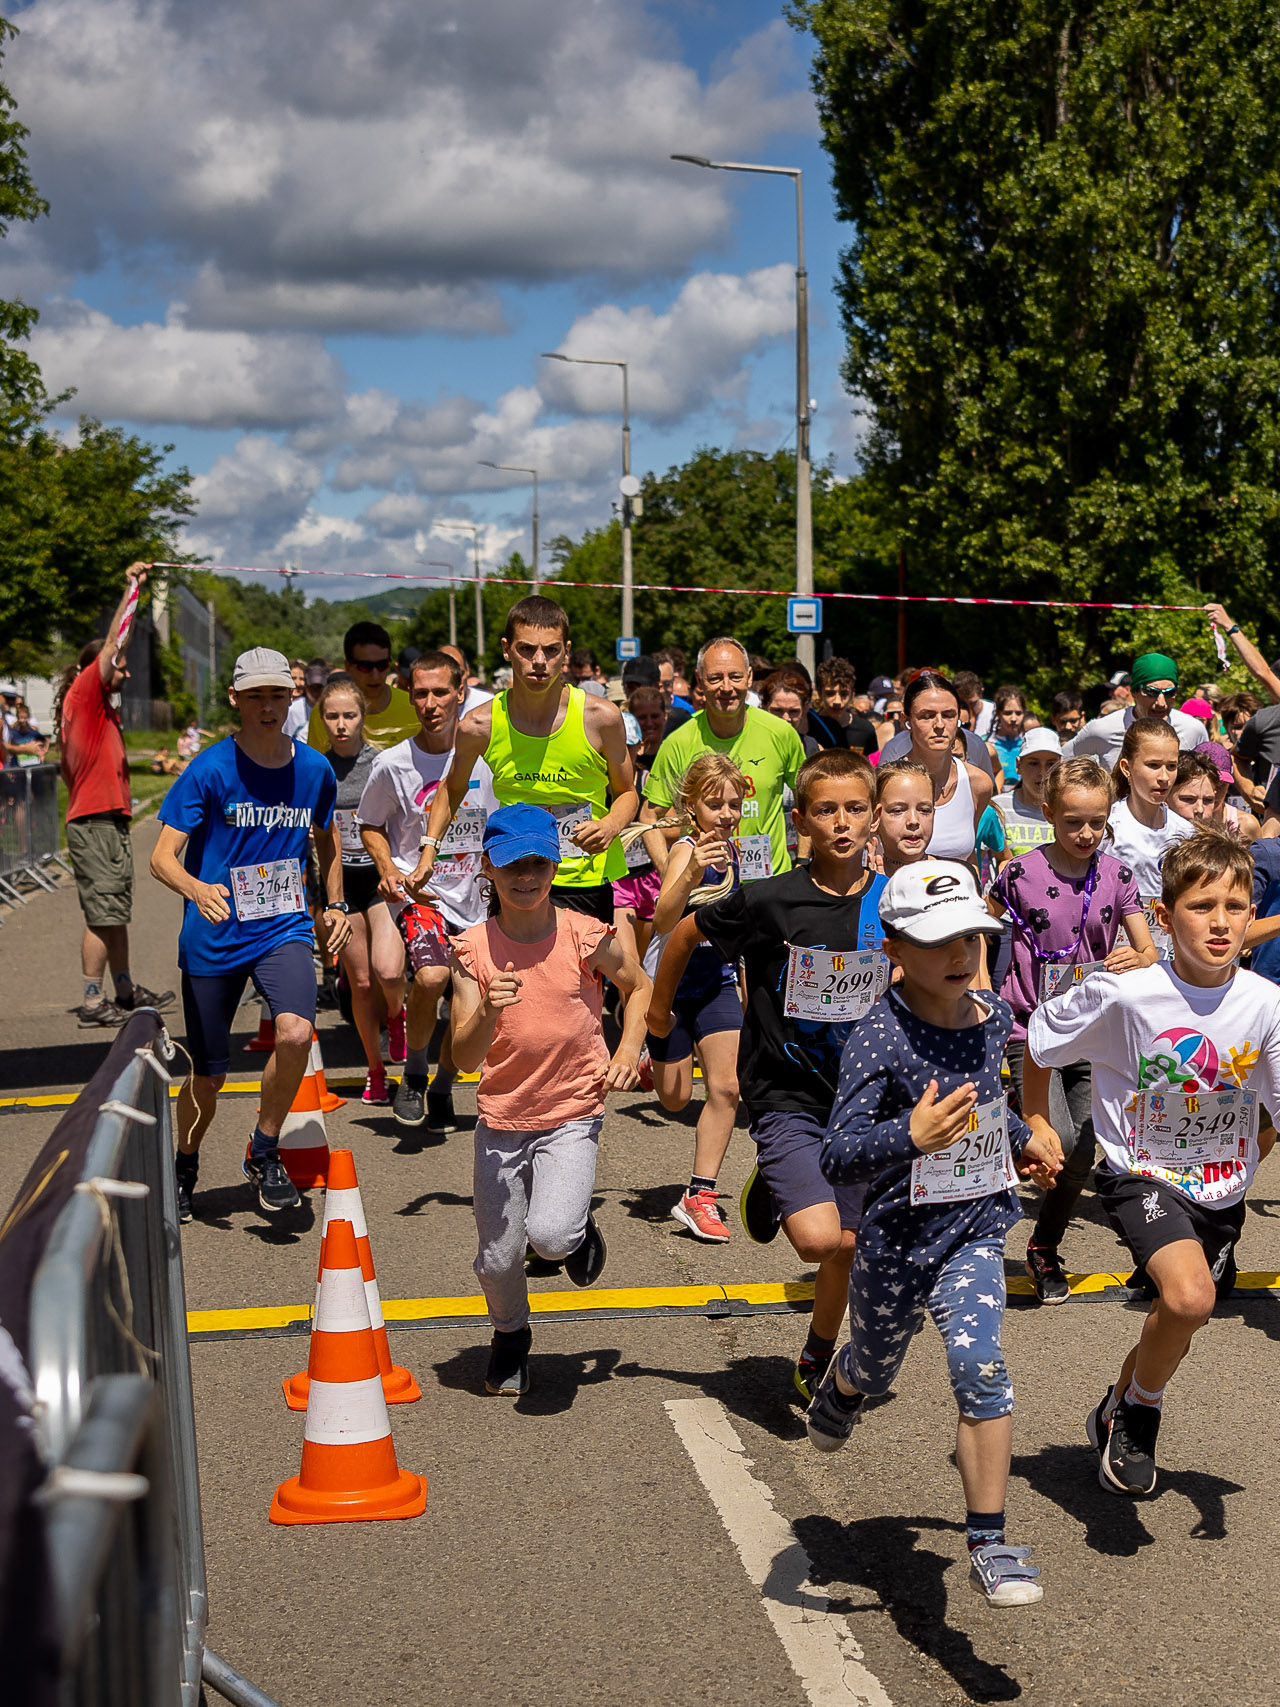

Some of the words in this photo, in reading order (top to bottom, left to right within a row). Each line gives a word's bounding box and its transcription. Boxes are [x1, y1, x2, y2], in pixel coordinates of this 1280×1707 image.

[513, 772, 567, 782] GARMIN
[447, 822, 480, 836] 2695
[257, 876, 290, 897] 2764
[821, 971, 874, 995] 2699
[1174, 1111, 1236, 1137] 2549
[1240, 1106, 1249, 1126] 2549
[954, 1127, 1003, 1163] 2502
